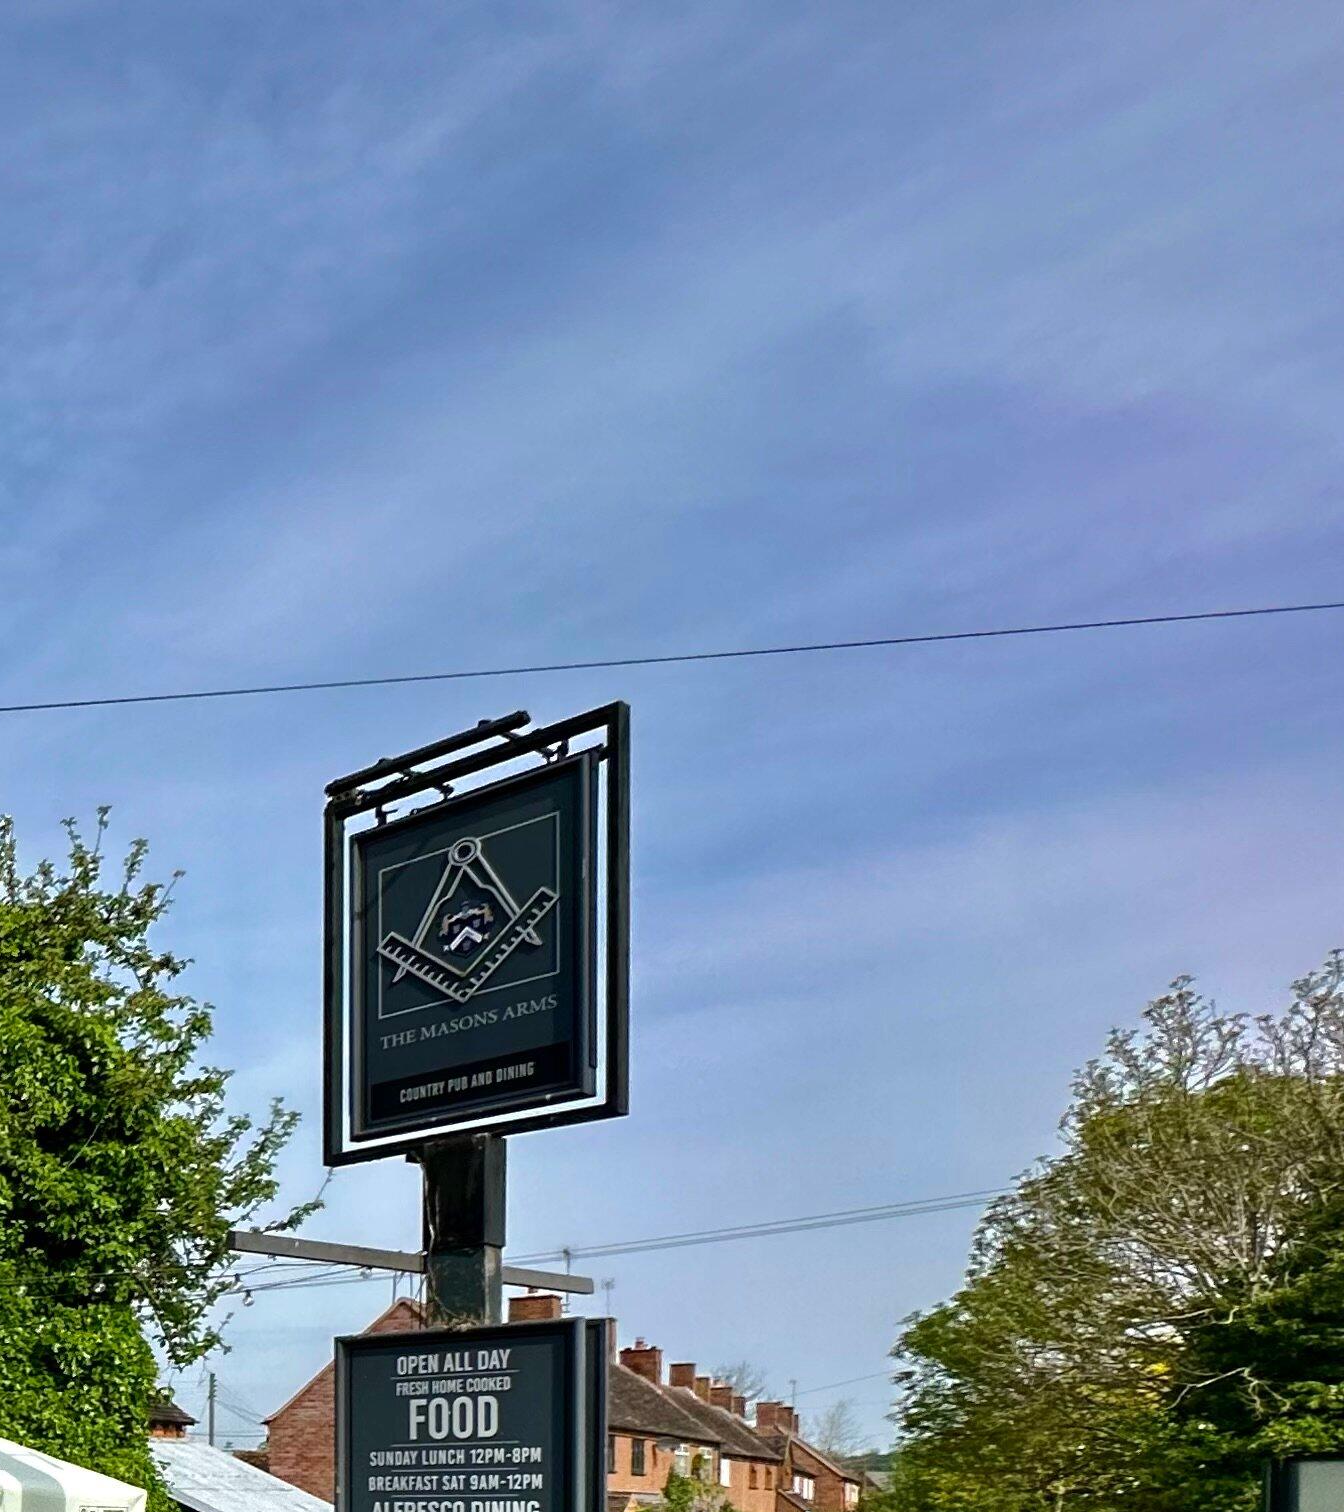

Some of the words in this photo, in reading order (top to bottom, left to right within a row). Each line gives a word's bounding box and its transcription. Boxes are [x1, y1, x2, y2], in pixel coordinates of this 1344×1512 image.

[380, 1029, 417, 1050] THE
[420, 1009, 499, 1041] MASONS
[502, 994, 558, 1022] ARMS
[399, 1080, 445, 1104] COUNTRY
[447, 1075, 469, 1093] PUB
[470, 1070, 493, 1089] AND
[496, 1061, 535, 1083] DINING
[396, 1354, 439, 1376] OPEN
[443, 1351, 474, 1373] ALL
[477, 1349, 512, 1371] DAY
[395, 1380, 429, 1397] FRESH
[431, 1378, 464, 1394] HOME
[466, 1376, 512, 1392] COOKED
[409, 1395, 499, 1440] FOOD
[369, 1450, 418, 1467] SUNDAY
[421, 1449, 466, 1466] LUNCH
[469, 1447, 543, 1464] 12PM-8PM
[368, 1475, 439, 1492] BREAKFAST
[442, 1474, 467, 1491] SAT
[469, 1473, 544, 1491] 9AM-12PM
